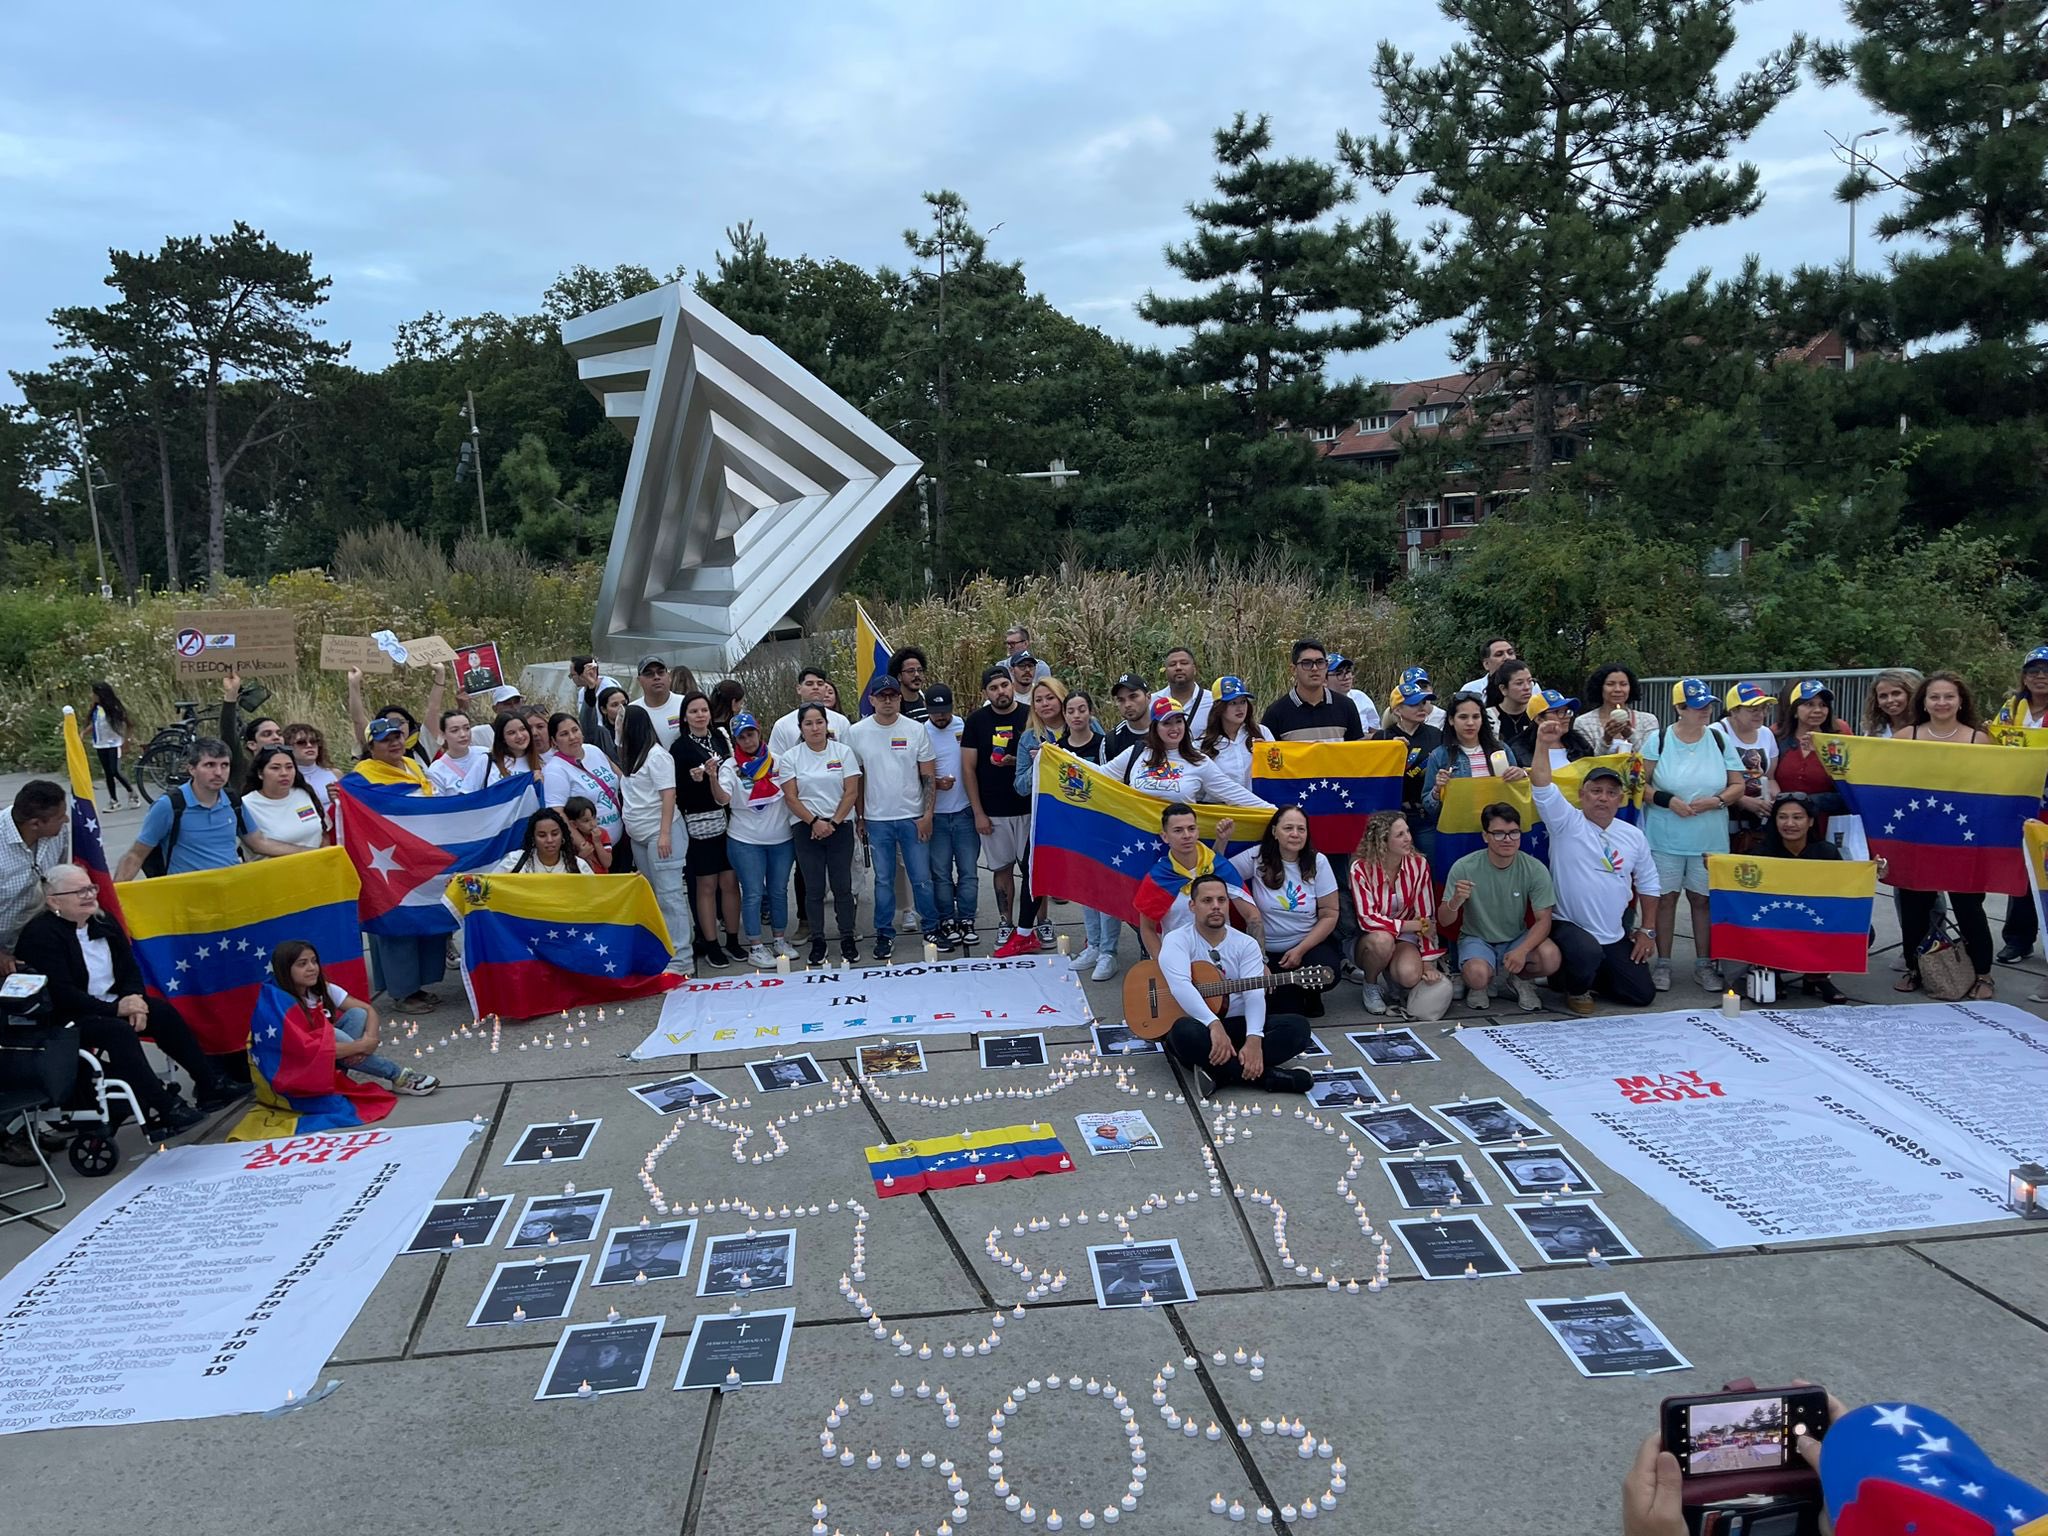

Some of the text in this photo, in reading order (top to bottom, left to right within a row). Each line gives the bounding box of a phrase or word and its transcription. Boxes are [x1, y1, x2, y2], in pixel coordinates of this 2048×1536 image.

[181, 660, 233, 673] FREEDOM
[1134, 778, 1180, 793] VZLA
[686, 960, 1036, 993] DEAD IN PROTESTS
[828, 994, 868, 1007] IN
[1613, 1070, 1705, 1090] MAY
[1620, 1081, 1727, 1104] 2017
[241, 1131, 392, 1157] APRIL
[243, 1146, 369, 1169] 2017
[274, 1279, 300, 1289] 27
[231, 1327, 260, 1339] 15
[220, 1340, 247, 1351] 20
[210, 1353, 237, 1364] 16
[201, 1365, 228, 1377] 19
